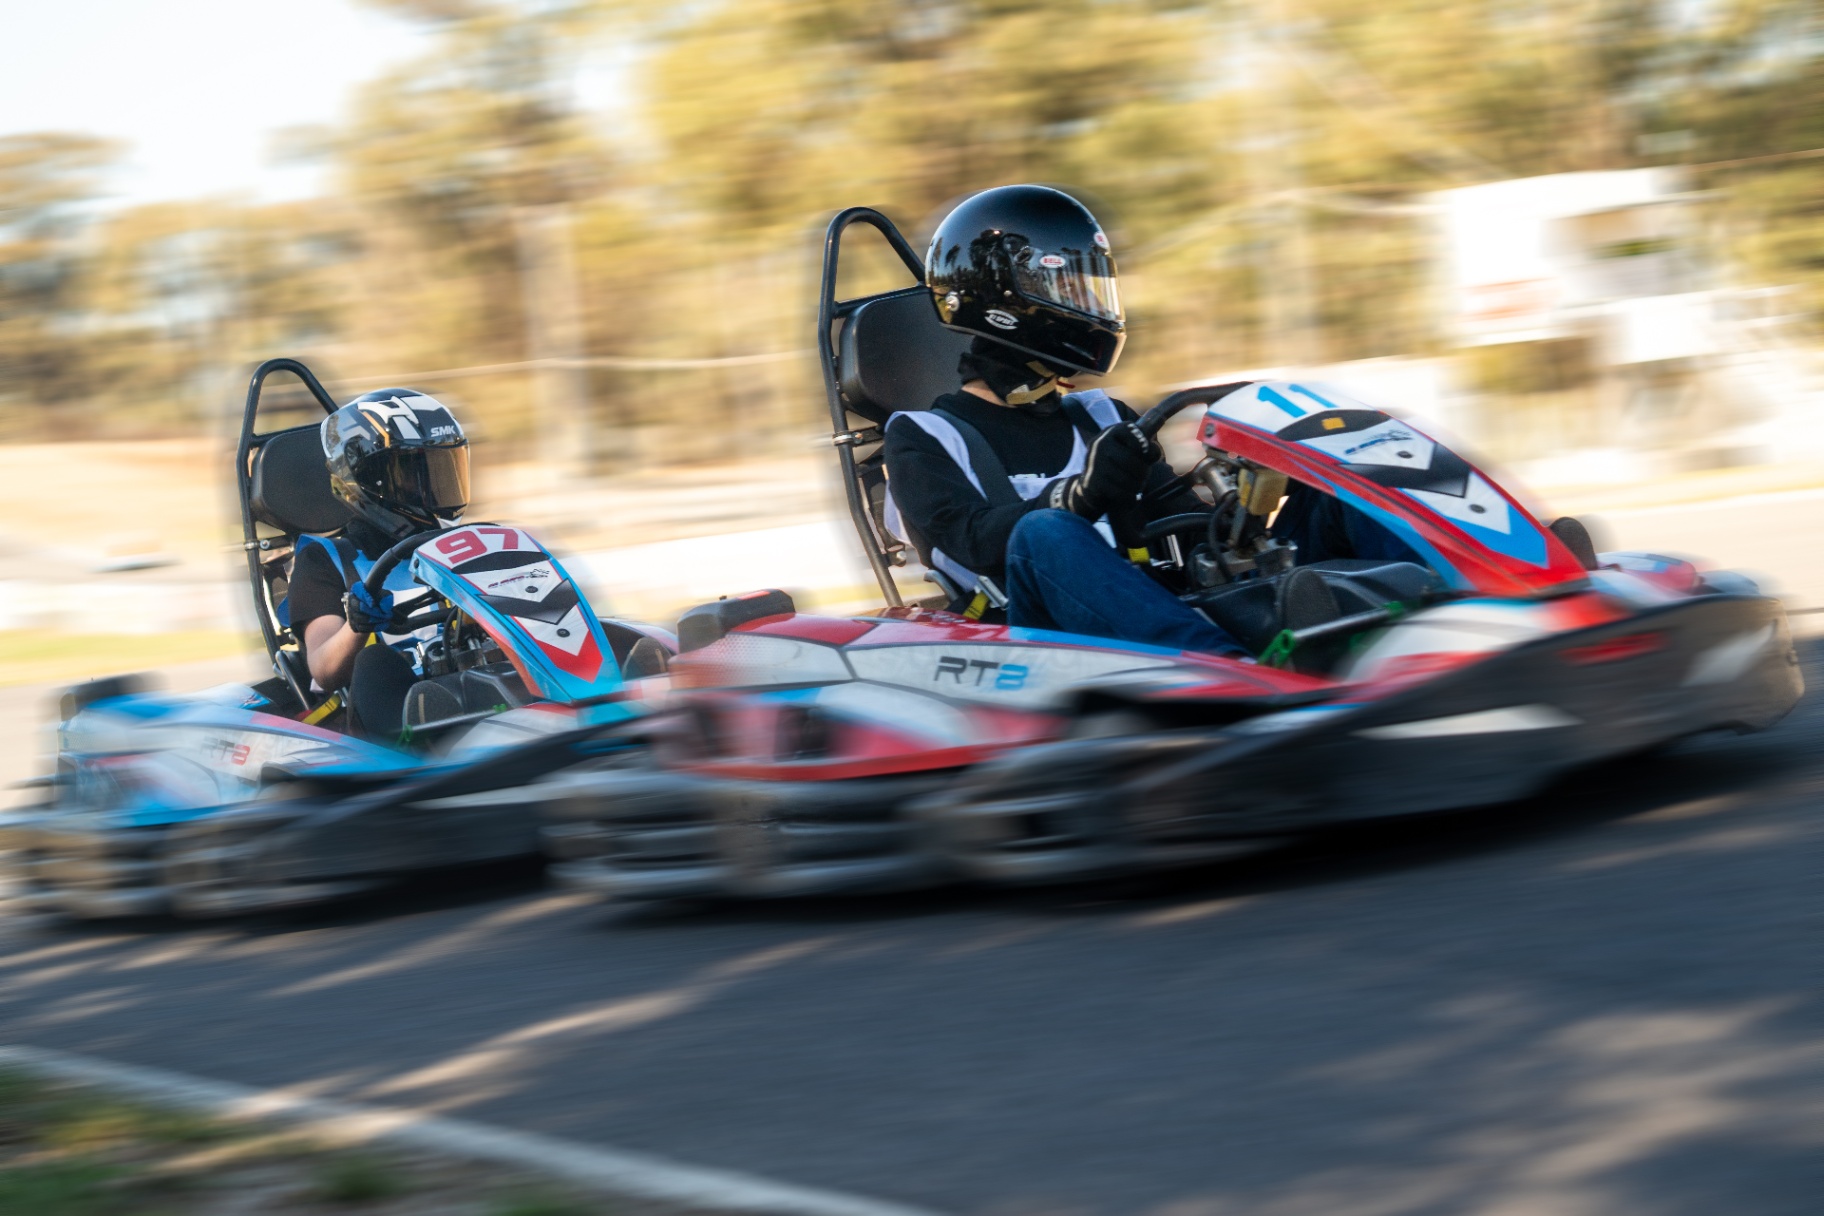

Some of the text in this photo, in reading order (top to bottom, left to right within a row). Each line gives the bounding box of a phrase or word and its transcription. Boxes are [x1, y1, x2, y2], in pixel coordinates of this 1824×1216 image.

[1256, 384, 1340, 418] 11
[430, 425, 456, 438] SMK
[435, 528, 519, 565] 97
[933, 655, 1029, 692] RT8
[200, 736, 251, 767] RT8
